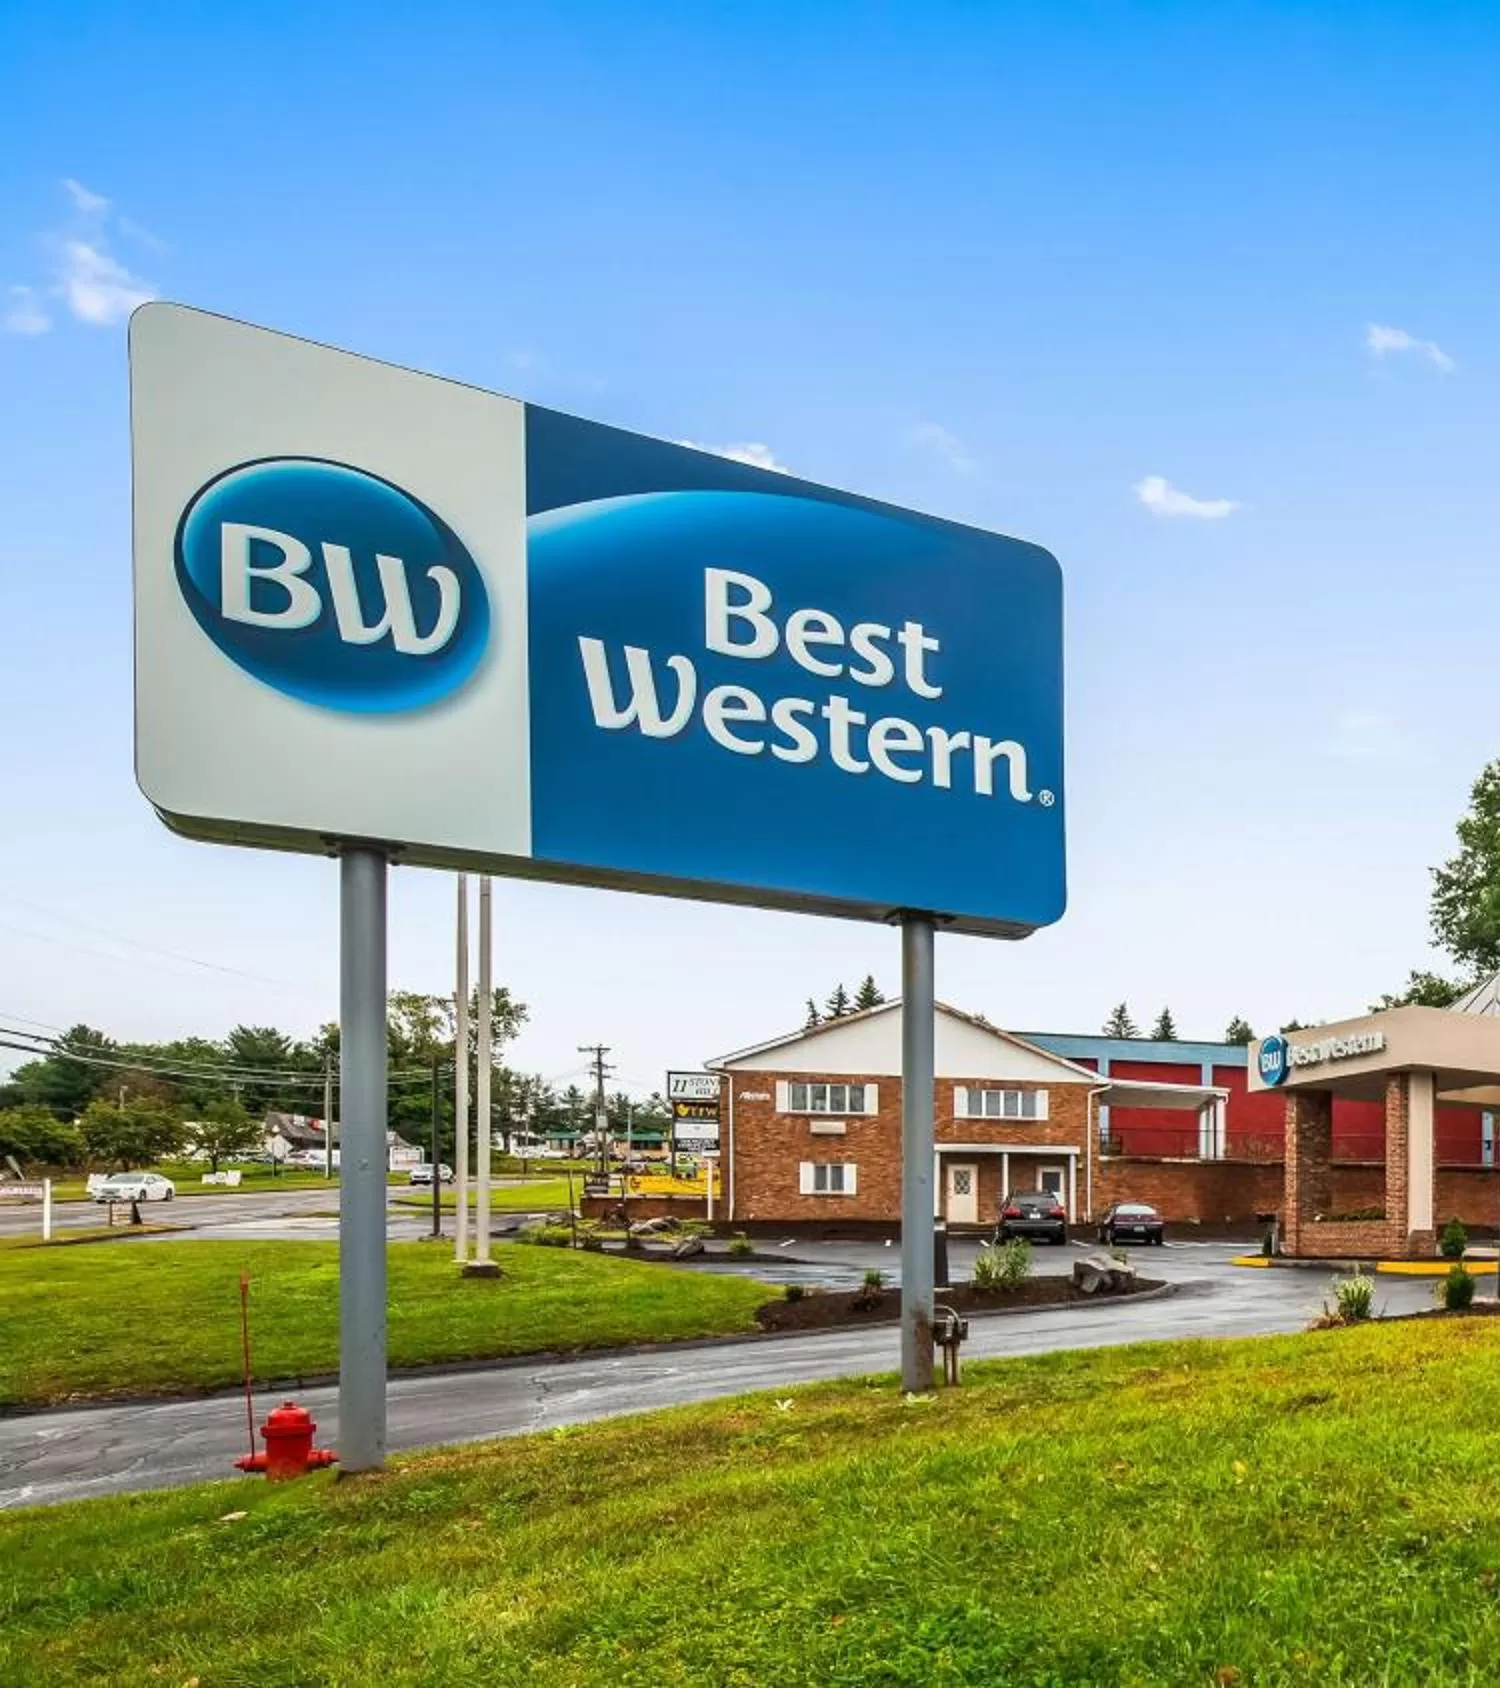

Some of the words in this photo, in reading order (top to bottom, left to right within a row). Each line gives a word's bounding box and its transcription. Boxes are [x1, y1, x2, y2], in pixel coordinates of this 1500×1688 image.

[221, 521, 461, 656] BW
[704, 566, 943, 700] Best
[1261, 1051, 1281, 1073] BW
